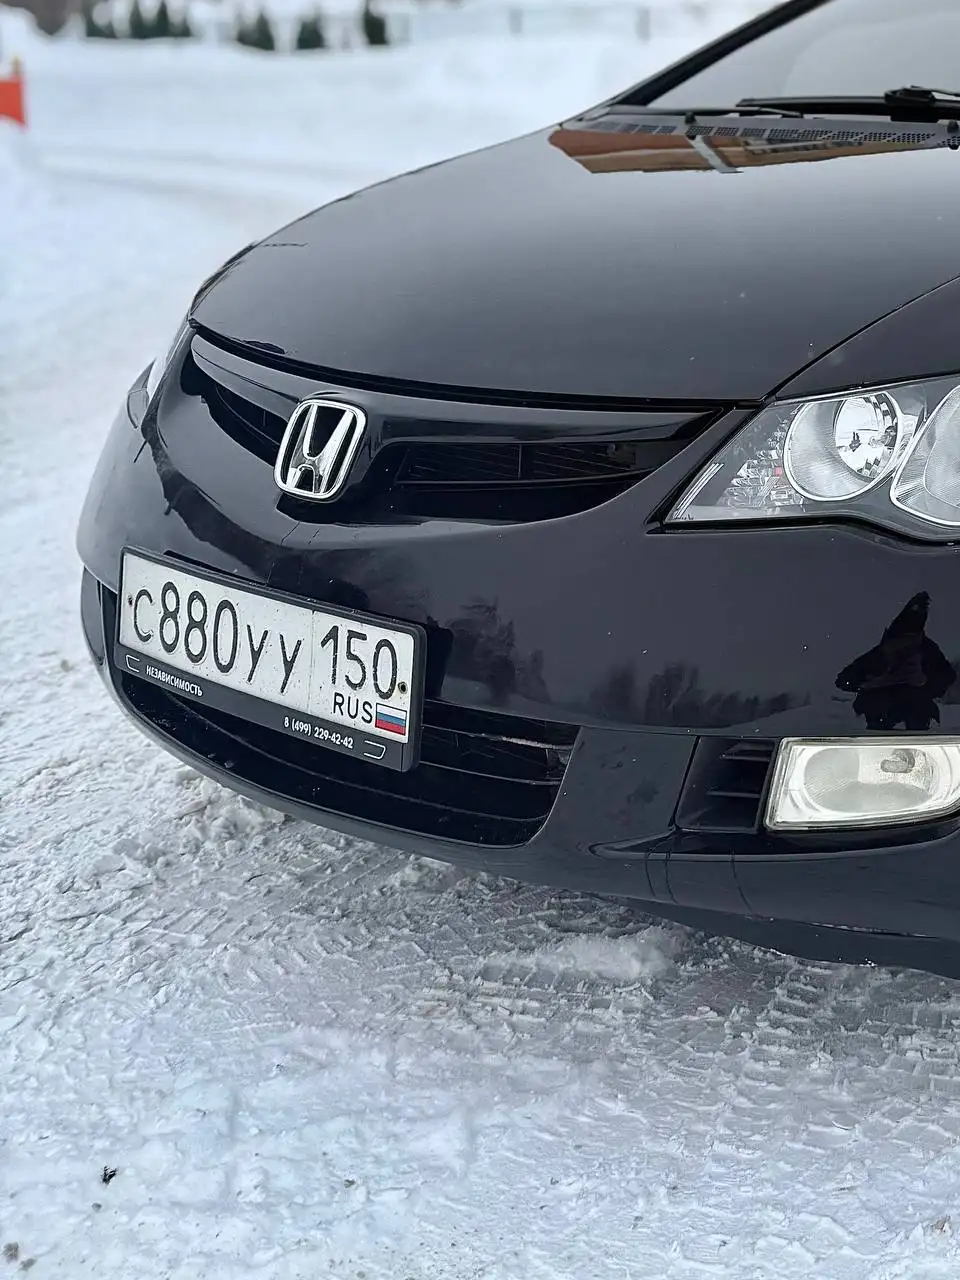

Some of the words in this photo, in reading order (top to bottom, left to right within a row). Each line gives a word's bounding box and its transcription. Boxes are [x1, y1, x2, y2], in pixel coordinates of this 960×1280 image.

[320, 625, 398, 700] 150
[146, 665, 203, 696] НЕЗАВИСИМОСТЬ
[332, 692, 373, 724] RUS
[284, 717, 289, 728] 8
[291, 718, 312, 736] (499)
[313, 727, 354, 749] 229-42-42
